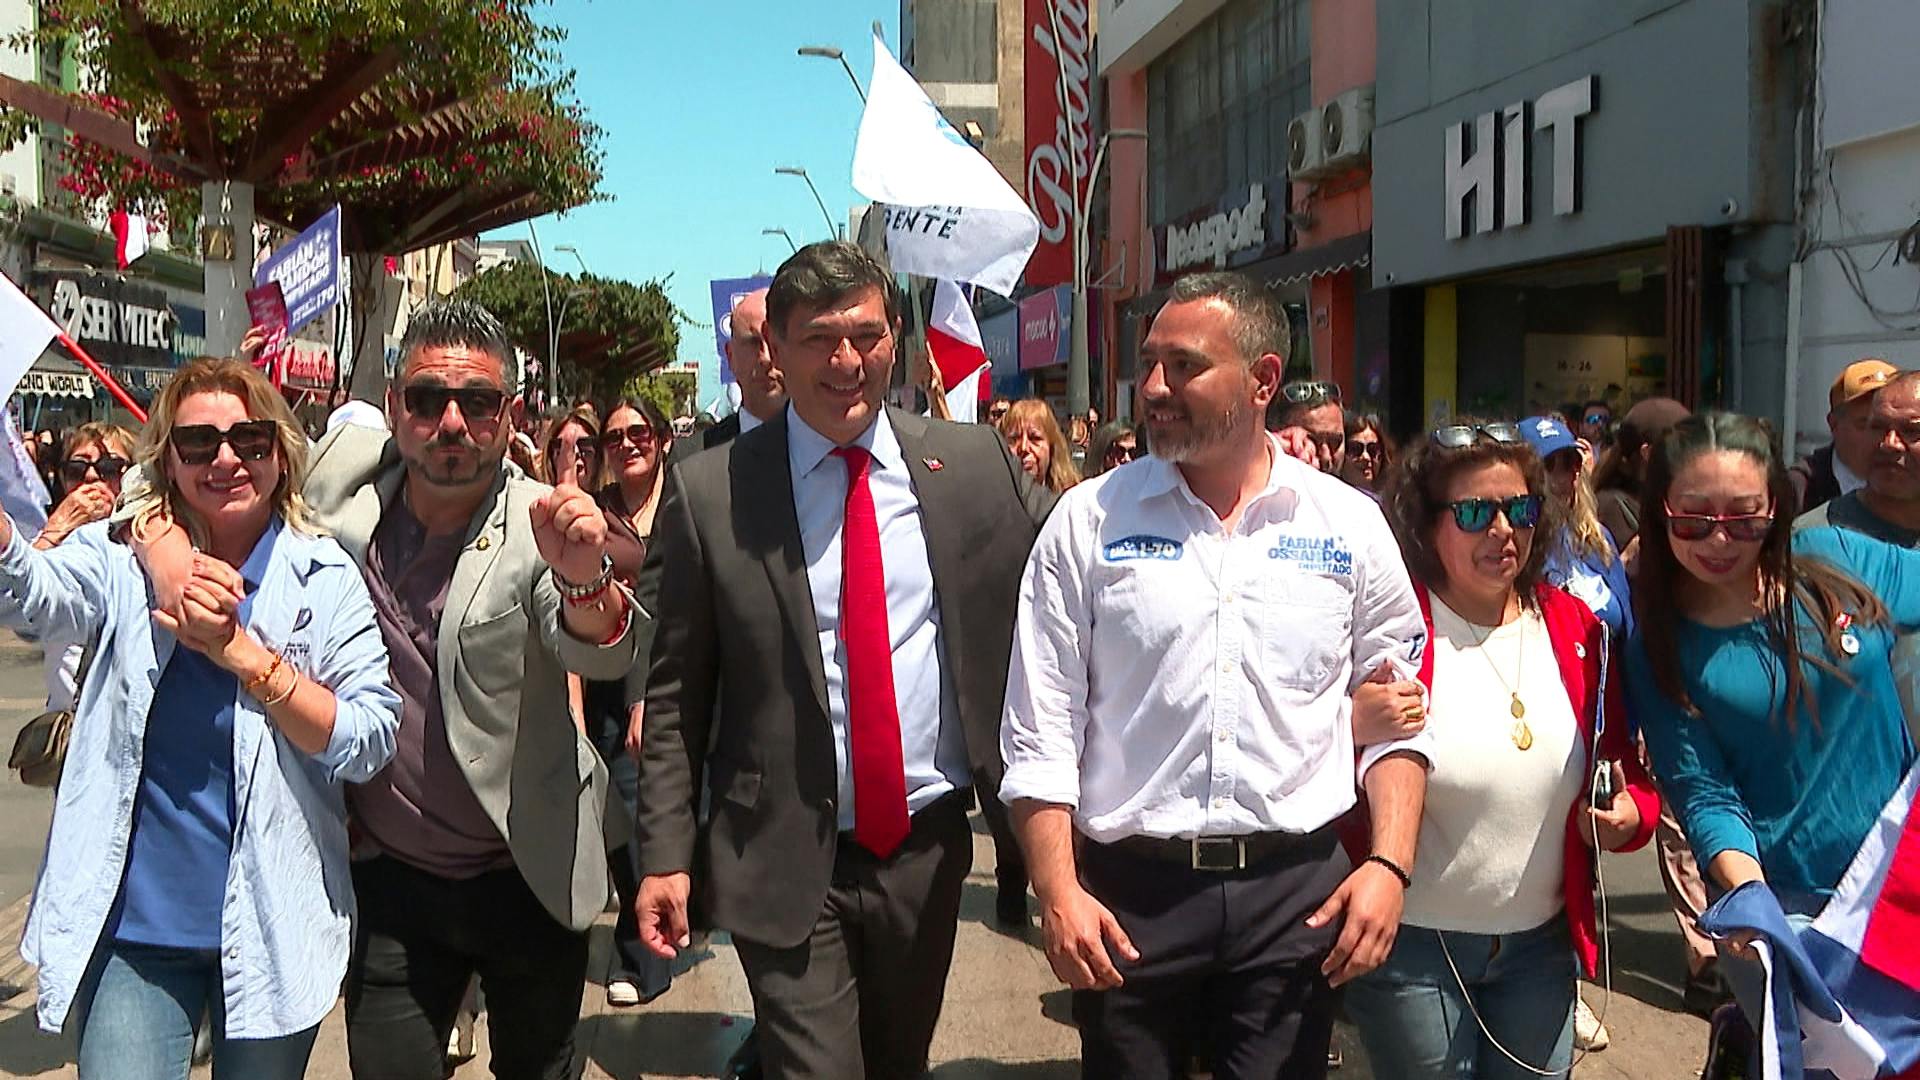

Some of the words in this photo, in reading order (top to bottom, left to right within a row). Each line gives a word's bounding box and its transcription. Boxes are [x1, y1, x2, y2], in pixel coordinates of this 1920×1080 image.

[1445, 75, 1598, 240] HIT
[80, 296, 170, 349] SERVITEC
[50, 375, 84, 392] WORLD
